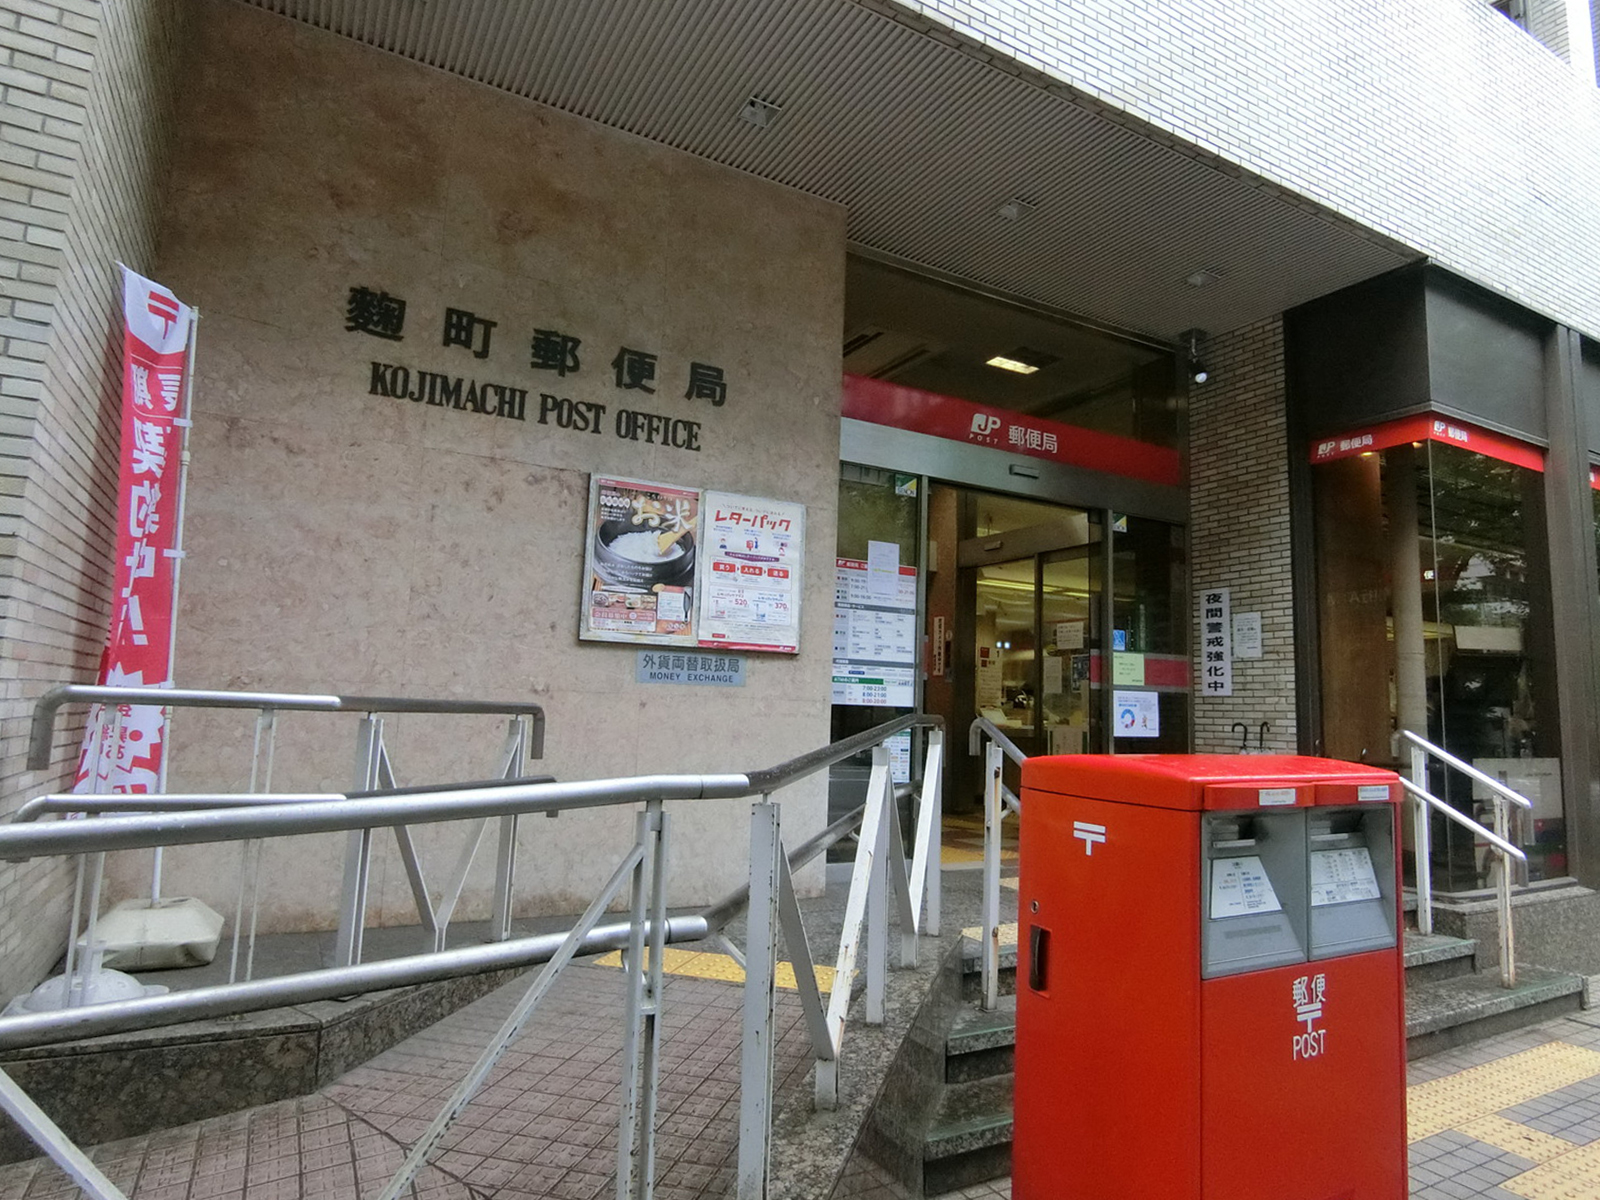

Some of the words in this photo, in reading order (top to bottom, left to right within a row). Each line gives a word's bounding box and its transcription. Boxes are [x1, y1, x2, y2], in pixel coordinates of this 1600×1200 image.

[368, 361, 528, 422] KOJIMACHI
[537, 392, 606, 434] POST
[616, 409, 702, 452] OFFICE
[969, 433, 998, 445] POST
[1008, 425, 1058, 454] 郵便局
[1340, 434, 1373, 451] 郵便局
[631, 496, 693, 532] お米
[715, 510, 791, 532] レターパック
[1204, 592, 1225, 692] 夜間警戒強化中
[643, 654, 740, 673] 外貨両替取扱局
[649, 672, 681, 681] MONEY
[687, 673, 734, 683] EXCHANGE
[1292, 973, 1326, 1008] 郵便
[1292, 1029, 1326, 1060] POST
